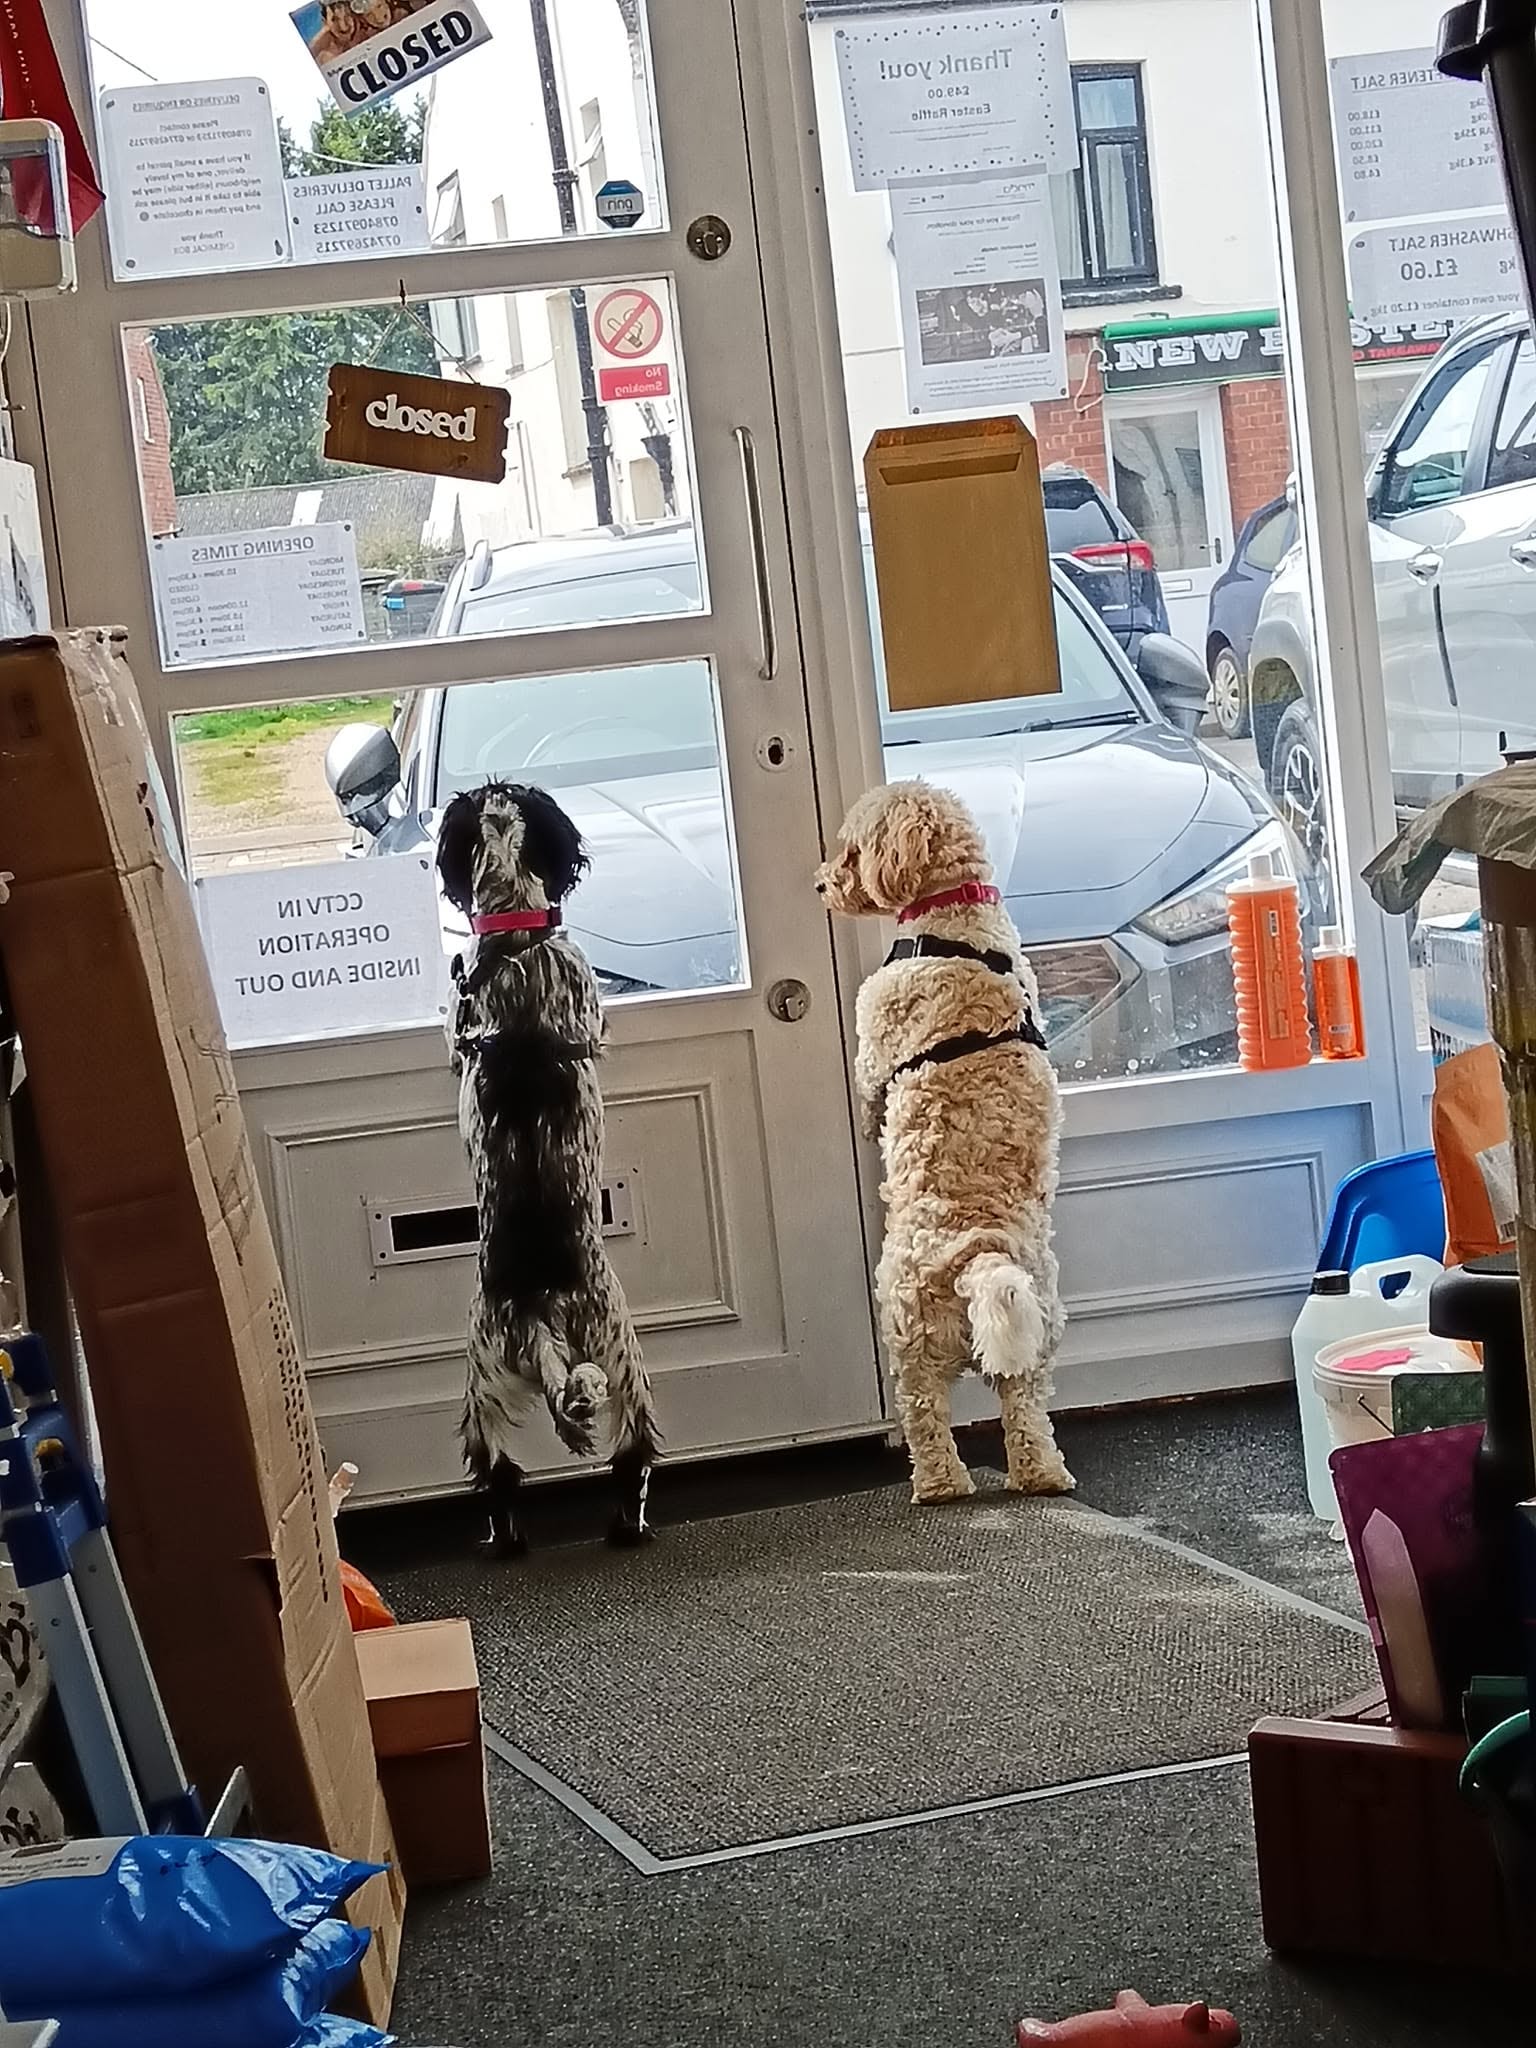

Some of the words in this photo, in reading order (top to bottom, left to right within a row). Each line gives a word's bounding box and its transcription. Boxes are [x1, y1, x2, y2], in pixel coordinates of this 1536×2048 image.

[340, 10, 473, 102] CLOSED
[1114, 331, 1248, 371] NEW
[366, 393, 476, 442] closed
